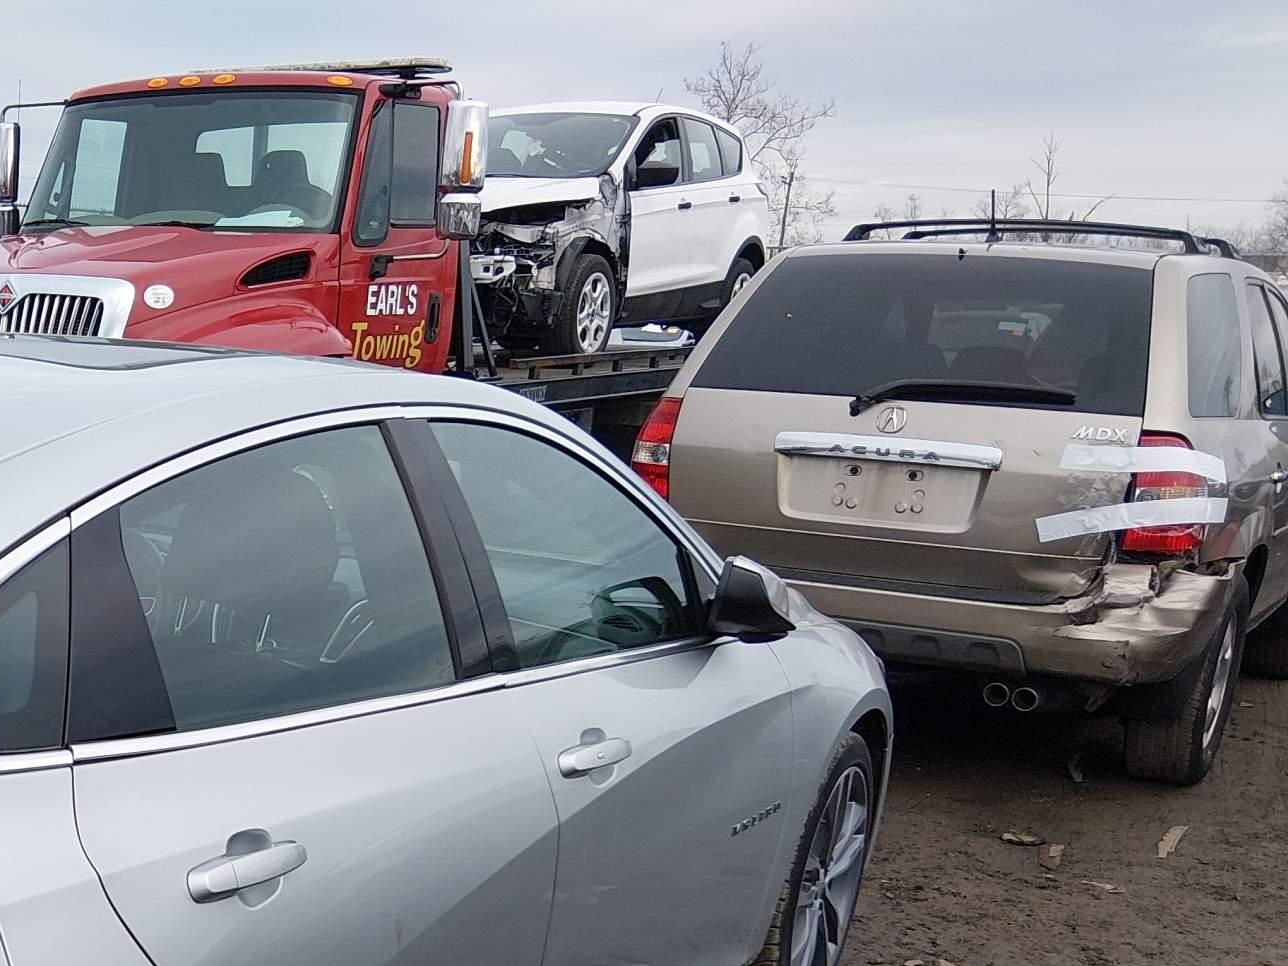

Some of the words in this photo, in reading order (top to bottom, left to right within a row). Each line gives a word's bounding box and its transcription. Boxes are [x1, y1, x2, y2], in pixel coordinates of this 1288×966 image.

[366, 283, 418, 316] EARL'S
[352, 319, 426, 369] Towing
[1070, 425, 1129, 443] MDX
[827, 443, 940, 461] ACURA
